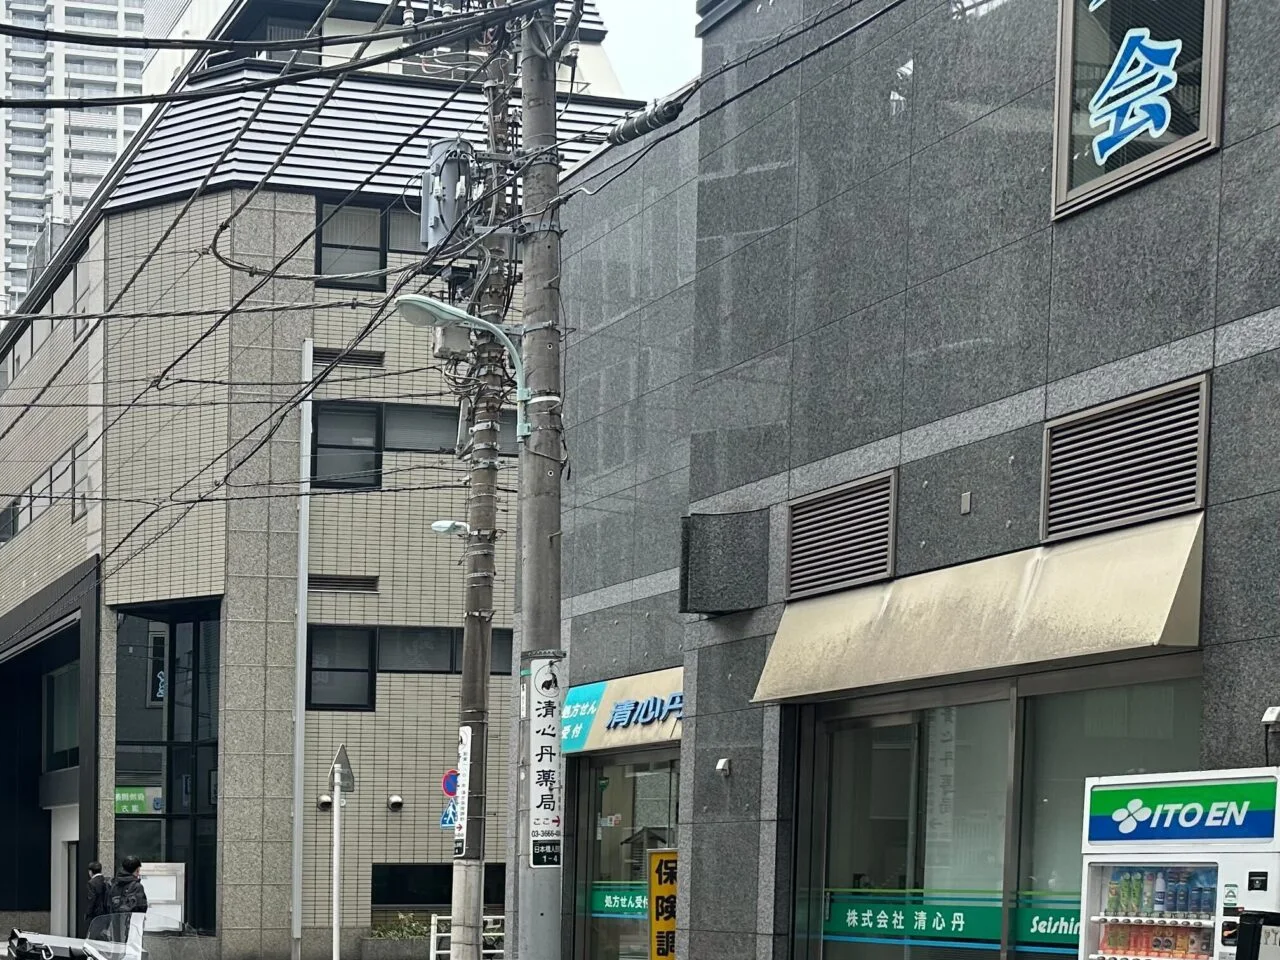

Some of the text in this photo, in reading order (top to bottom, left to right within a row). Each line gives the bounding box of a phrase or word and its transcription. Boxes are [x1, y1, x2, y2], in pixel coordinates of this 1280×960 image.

[1089, 27, 1183, 167] 会
[535, 699, 557, 812] 清心丹薬局
[533, 817, 550, 826] ここ
[1149, 800, 1250, 828] ITO EN
[845, 908, 965, 933] 株式会社 清心丹
